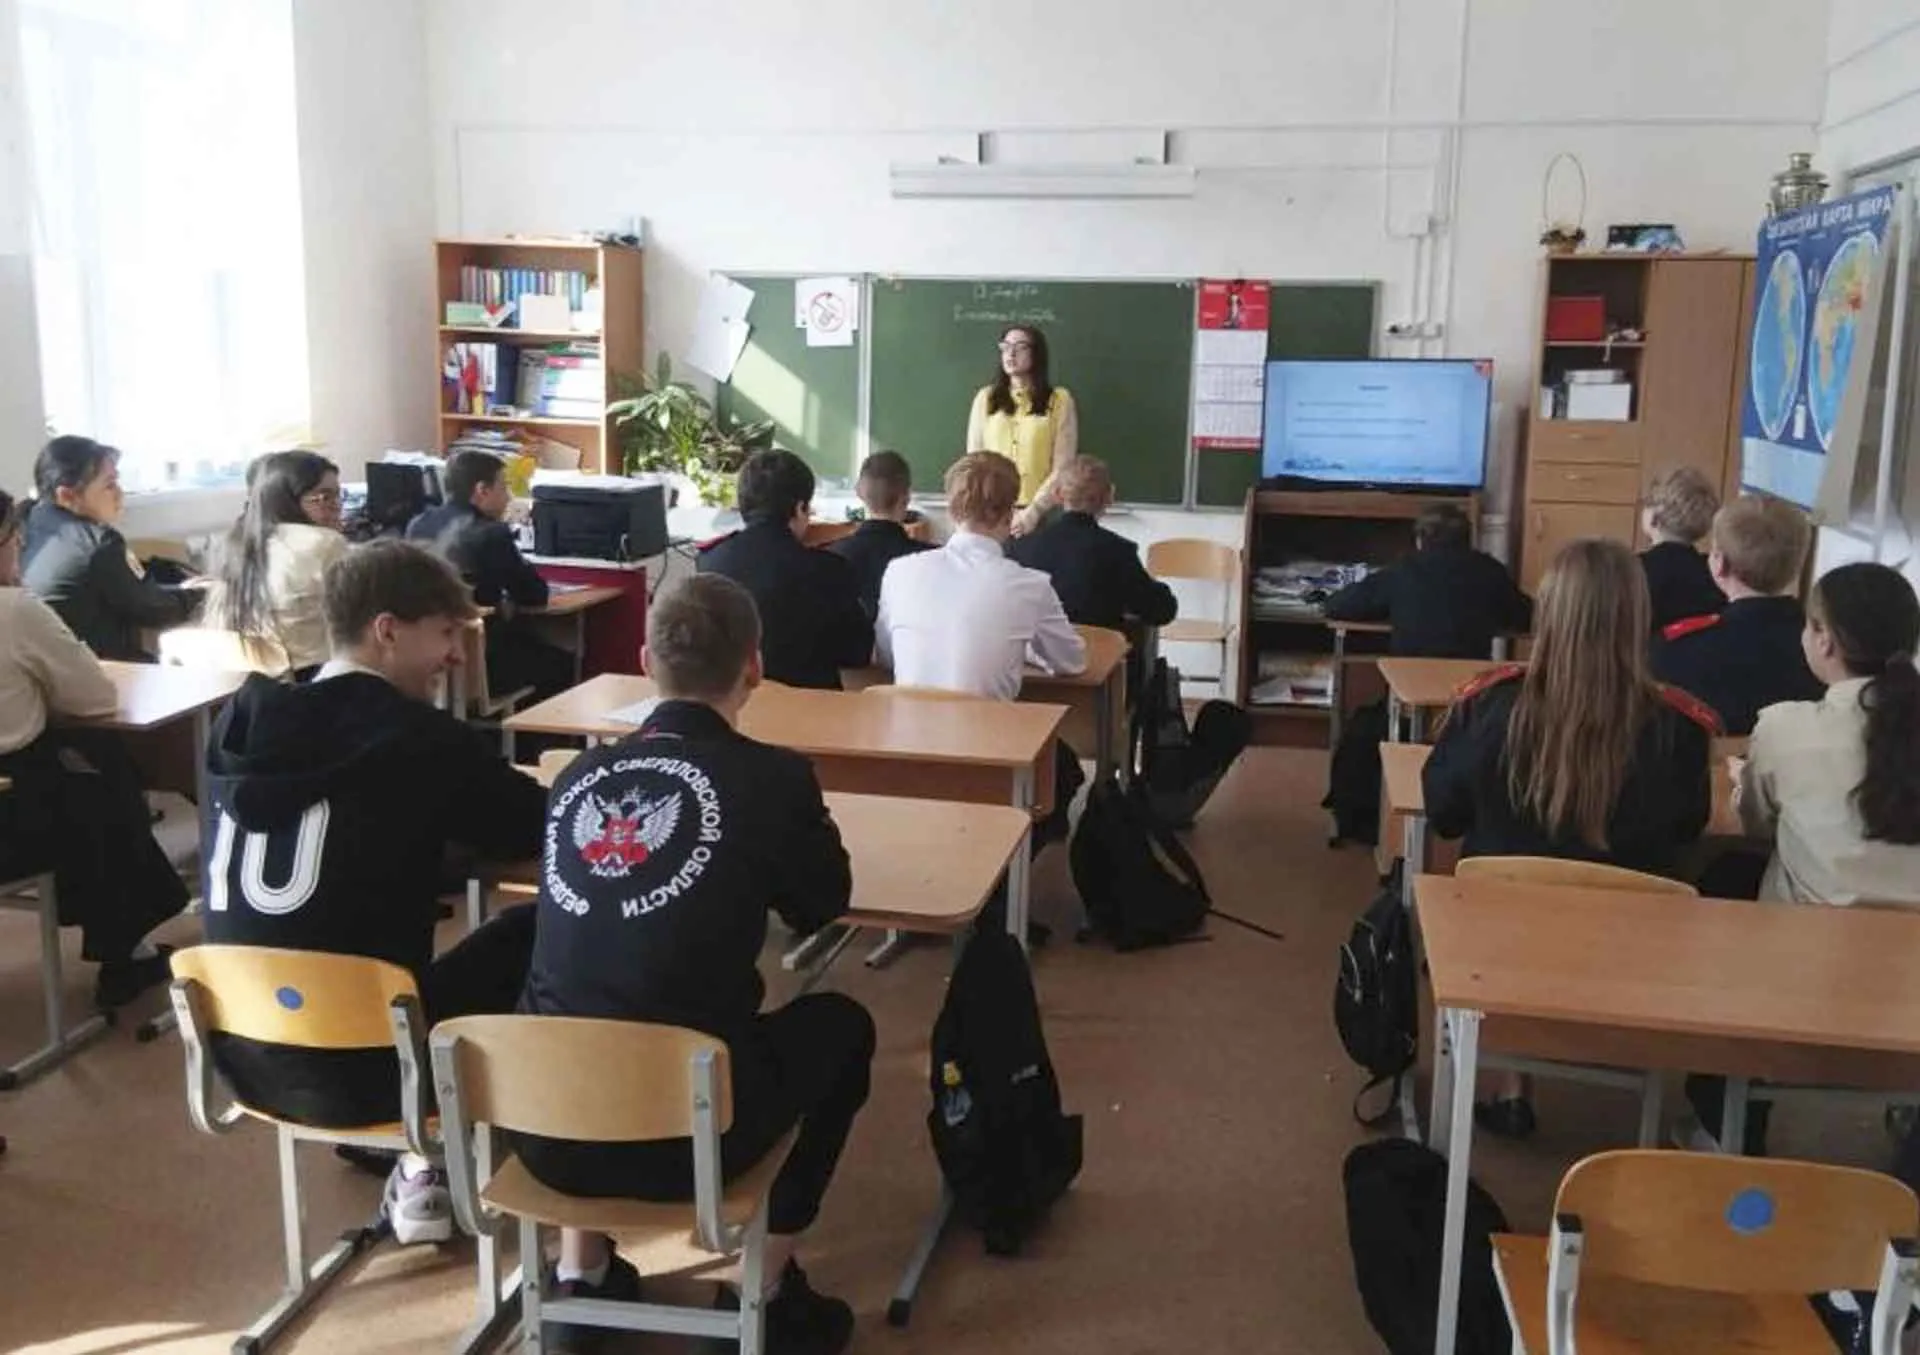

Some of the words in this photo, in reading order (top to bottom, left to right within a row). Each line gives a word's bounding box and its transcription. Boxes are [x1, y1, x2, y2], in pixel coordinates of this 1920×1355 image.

[552, 765, 611, 818] БОКСА
[612, 756, 723, 843] СВЕРДЛОВСКОЙ
[621, 846, 712, 919] ОБЛАСТИ
